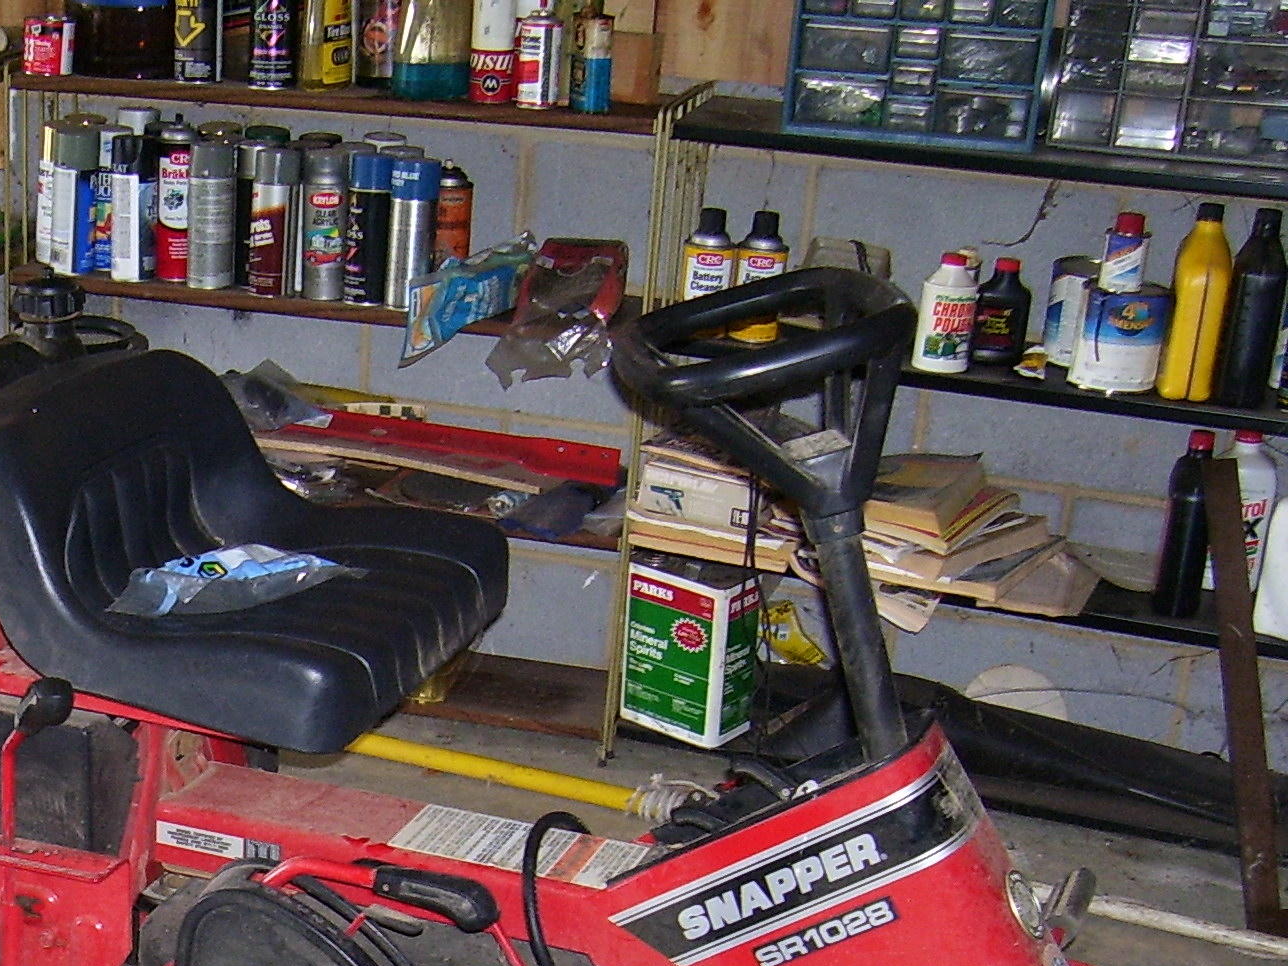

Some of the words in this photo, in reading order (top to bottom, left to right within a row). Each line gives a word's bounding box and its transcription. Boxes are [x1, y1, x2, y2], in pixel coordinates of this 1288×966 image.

[699, 254, 724, 265] CRC
[750, 257, 775, 268] CRC
[692, 270, 723, 284] Battery
[632, 579, 674, 602] PARKS
[629, 629, 669, 651] Mineral
[629, 640, 664, 661] Spirits
[677, 832, 883, 941] SNAPPER
